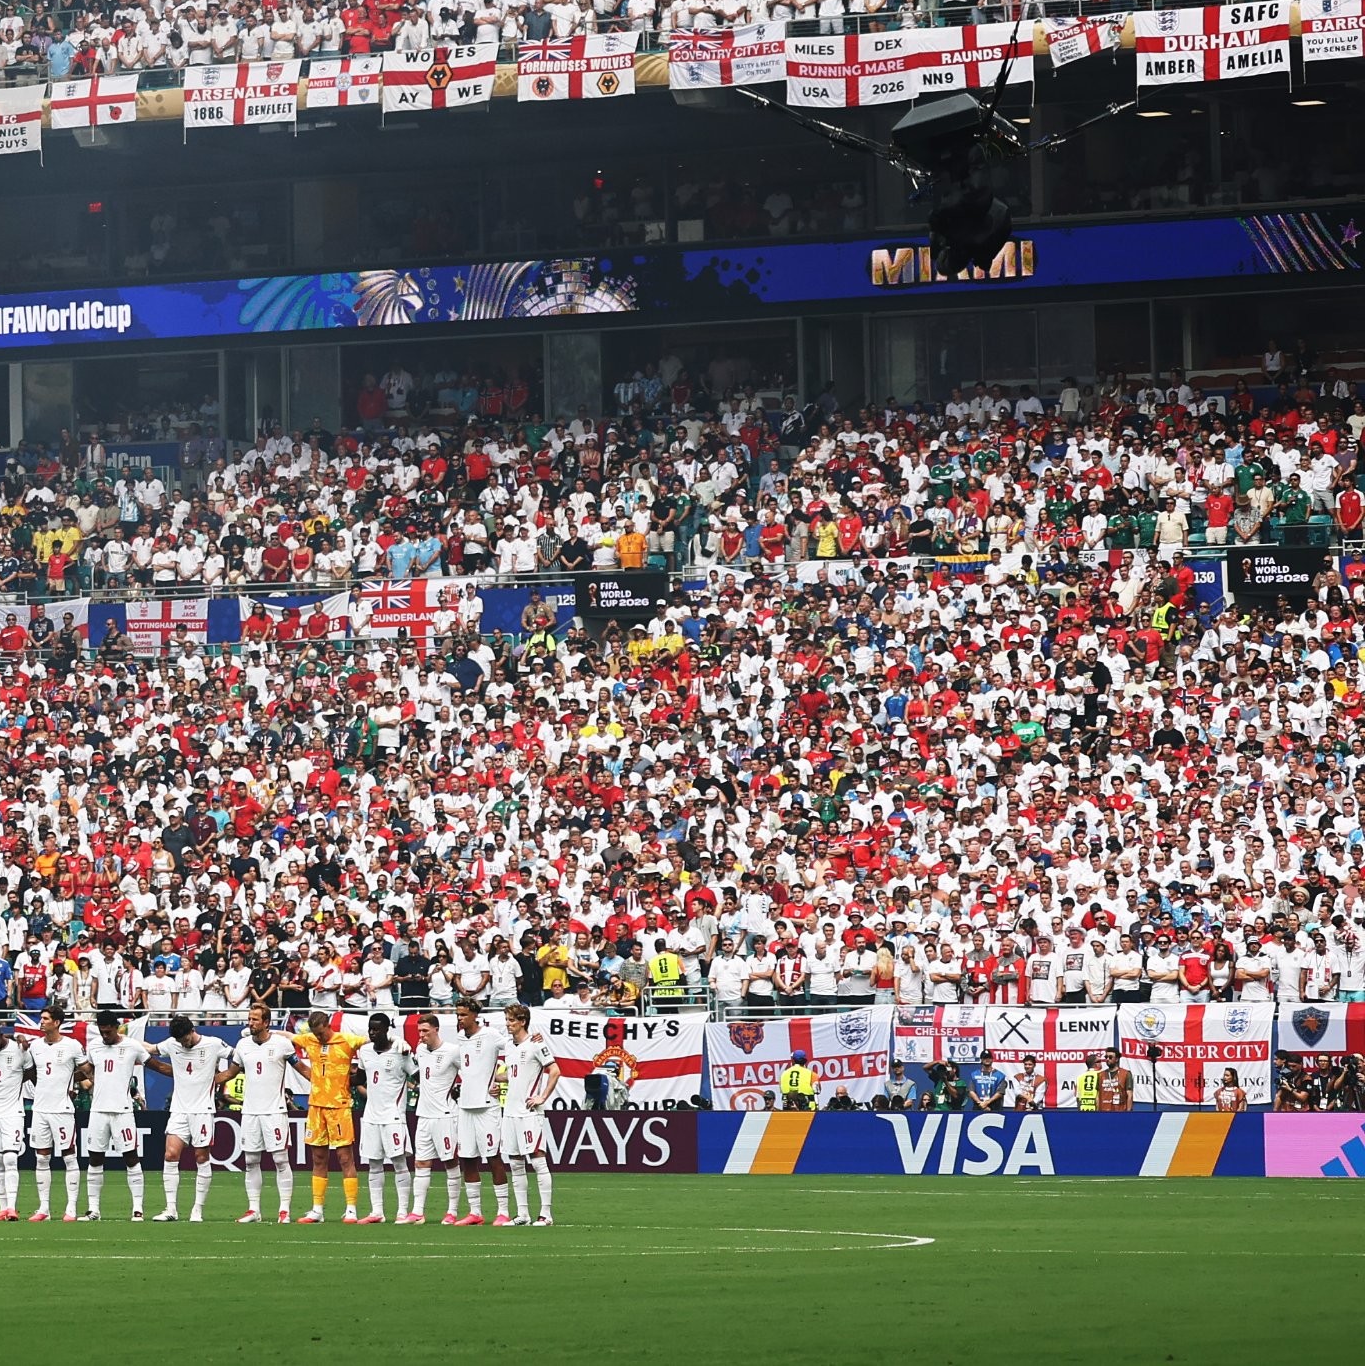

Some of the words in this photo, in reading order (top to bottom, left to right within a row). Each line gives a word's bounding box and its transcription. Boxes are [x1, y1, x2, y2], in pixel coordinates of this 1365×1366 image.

[1231, 2, 1279, 24] SAFC
[875, 38, 902, 51] DEX
[1164, 30, 1260, 52] DURHAM
[1307, 38, 1323, 46] YOU
[1327, 37, 1345, 45] FILL
[406, 46, 477, 63] WOLVES
[795, 44, 835, 56] MILES
[1309, 46, 1321, 54] MY
[1323, 44, 1357, 53] SENSES
[941, 48, 1002, 64] RAUNDS
[1227, 49, 1283, 70] AMELIA
[521, 60, 587, 74] FORDHOUSES
[590, 56, 632, 70] WOLVES
[799, 64, 861, 77] RUNNING
[865, 60, 905, 74] MARE
[1145, 59, 1195, 76] AMBER
[923, 72, 954, 85] NN9
[191, 86, 264, 102] ARSENAL
[269, 84, 289, 97] FC
[399, 92, 419, 104] AY
[458, 85, 483, 98] WE
[803, 86, 829, 98] USA
[873, 82, 905, 96] 2026
[193, 107, 223, 120] 1886
[248, 103, 292, 116] BENFLEET
[3, 115, 17, 124] FC
[0, 127, 27, 137] NICE
[1255, 557, 1275, 565] FIFA
[1255, 566, 1290, 574] WORLD
[1194, 572, 1215, 583] 130
[1255, 575, 1274, 583] CUP
[1275, 574, 1309, 583] 2026
[600, 582, 619, 591] FIFA
[600, 591, 631, 599] WORLD
[600, 599, 619, 607] CUP
[619, 598, 649, 607] 2026
[550, 1018, 680, 1041] BEECHY'S
[915, 1028, 960, 1036] CHELSEA
[1059, 1020, 1110, 1032] LENNY
[1223, 1044, 1265, 1058] CITY
[104, 1060, 113, 1072] 10
[511, 1064, 518, 1078] 18
[713, 1057, 857, 1087] BLACKOOL
[861, 1052, 889, 1076] FC
[876, 1113, 1056, 1176] VISA
